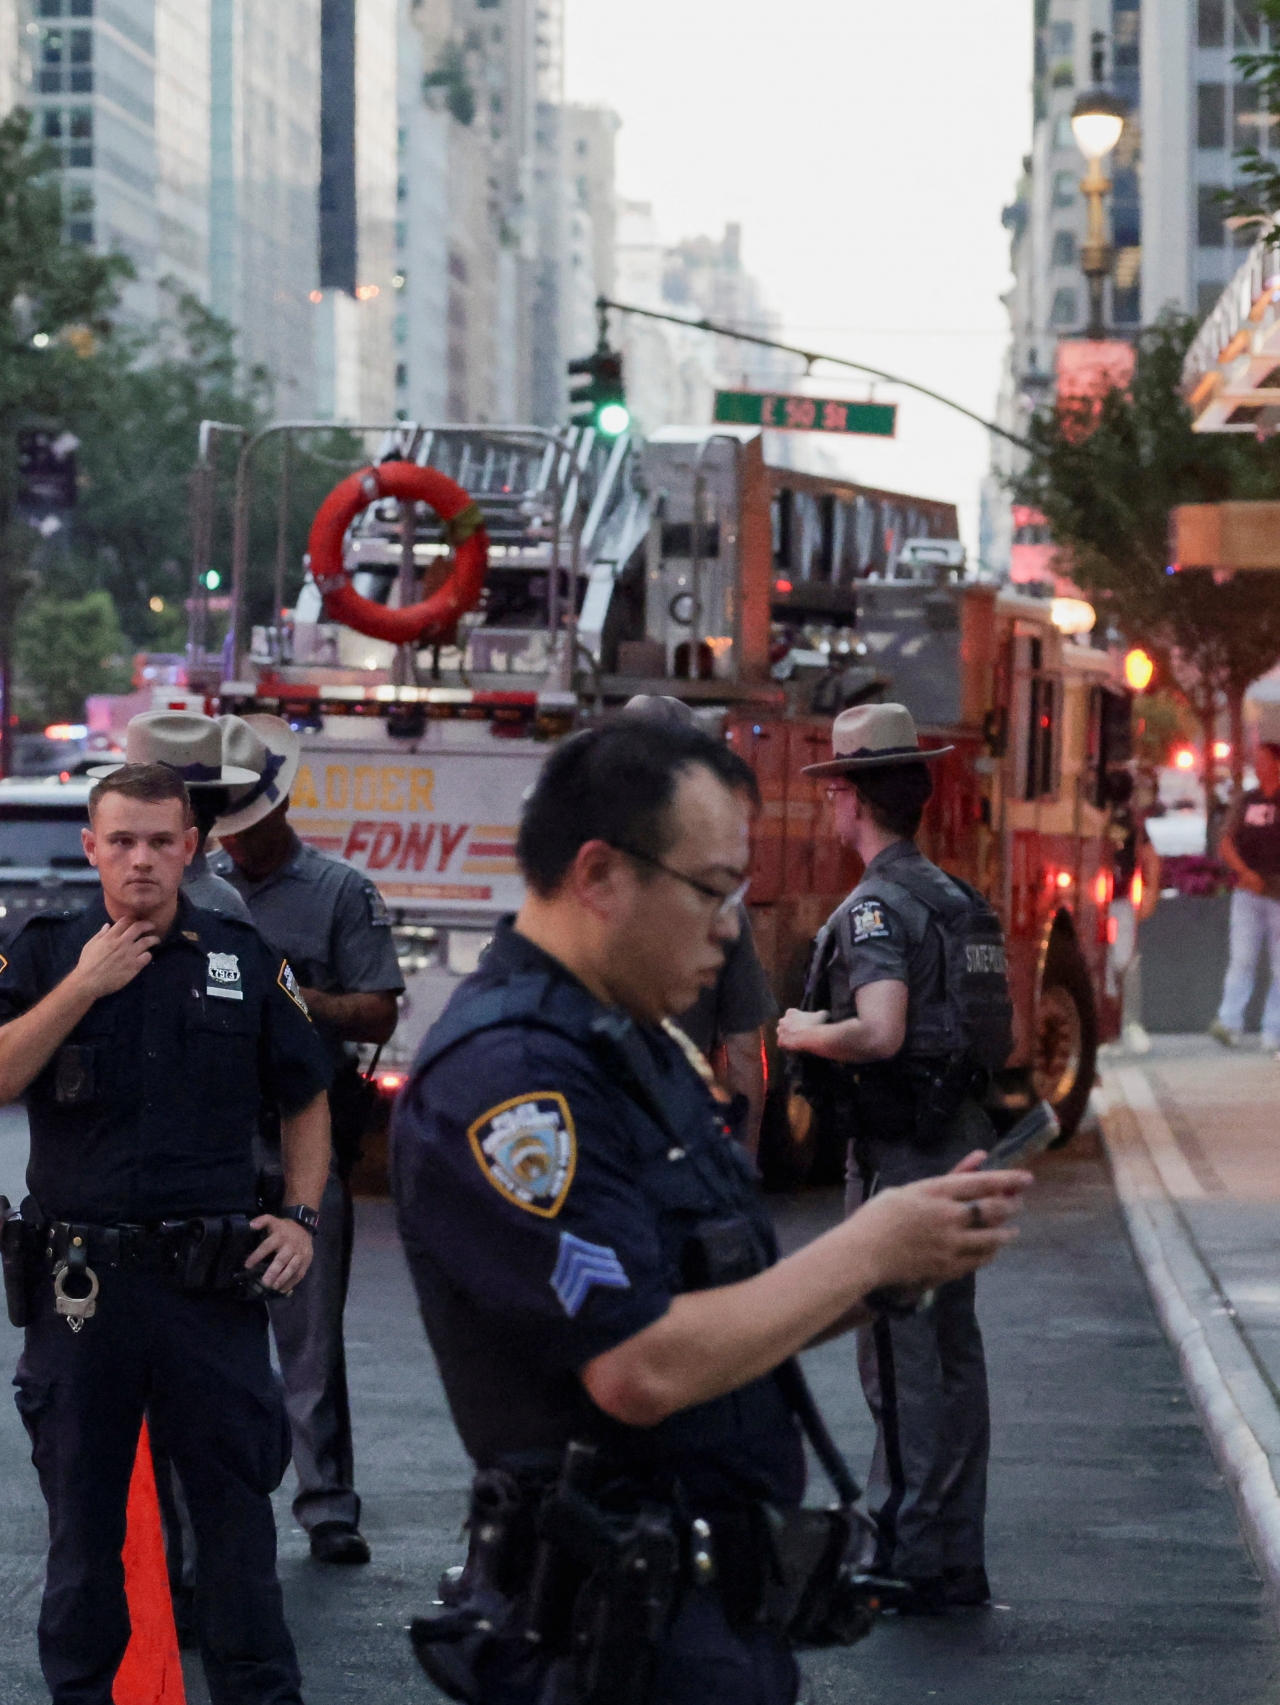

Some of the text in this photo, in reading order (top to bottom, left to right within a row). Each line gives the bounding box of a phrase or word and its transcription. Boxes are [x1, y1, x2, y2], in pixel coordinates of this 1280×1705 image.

[761, 398, 775, 424] E
[289, 763, 436, 812] ADDER
[342, 820, 470, 874] FDNY
